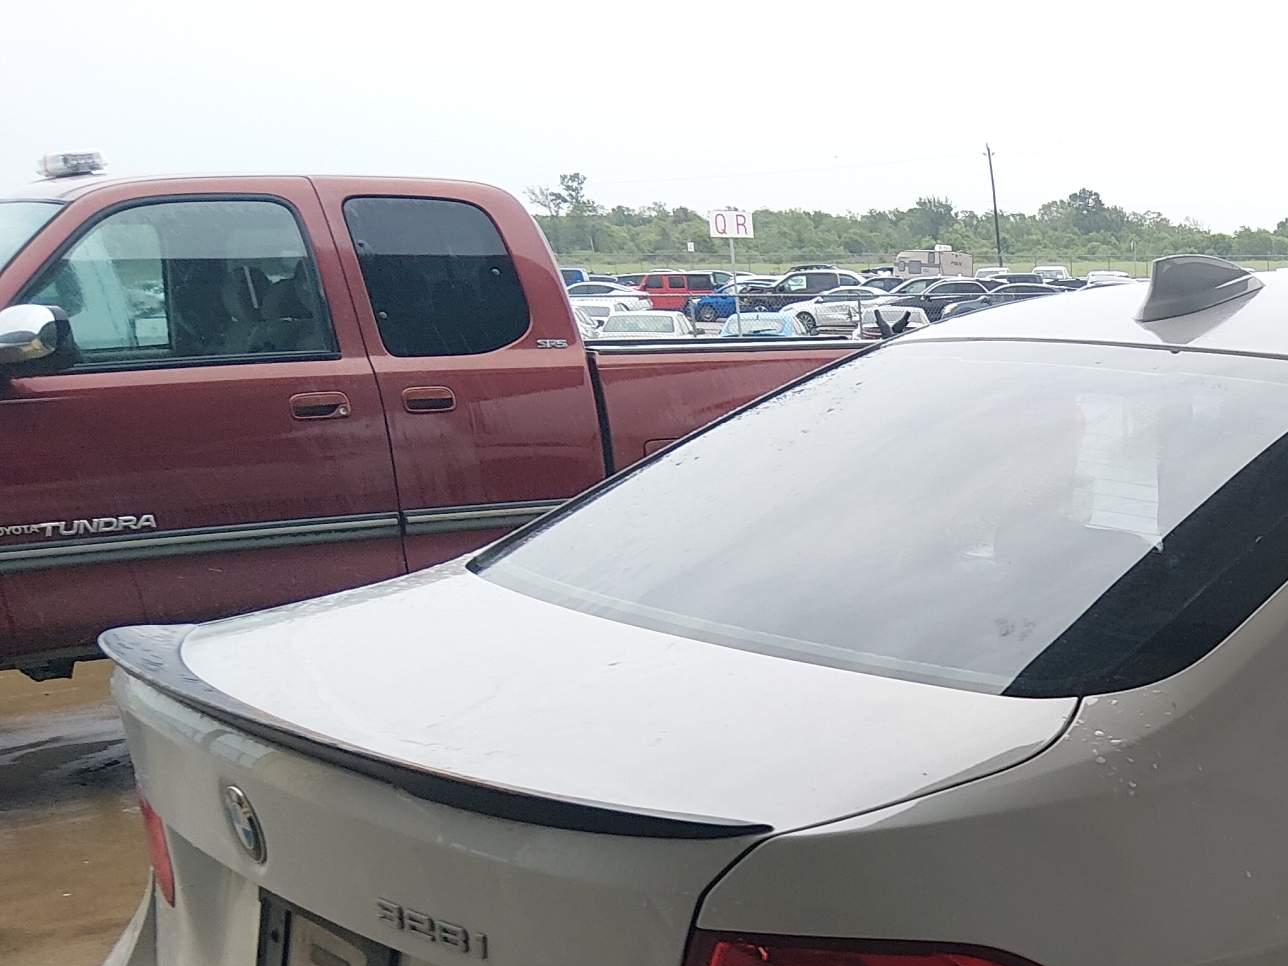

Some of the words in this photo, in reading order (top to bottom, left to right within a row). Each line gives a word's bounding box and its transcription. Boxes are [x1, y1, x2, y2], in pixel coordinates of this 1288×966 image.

[714, 213, 728, 235] Q
[735, 214, 748, 235] R
[0, 524, 40, 536] YOTA
[39, 514, 156, 537] TUNDRA
